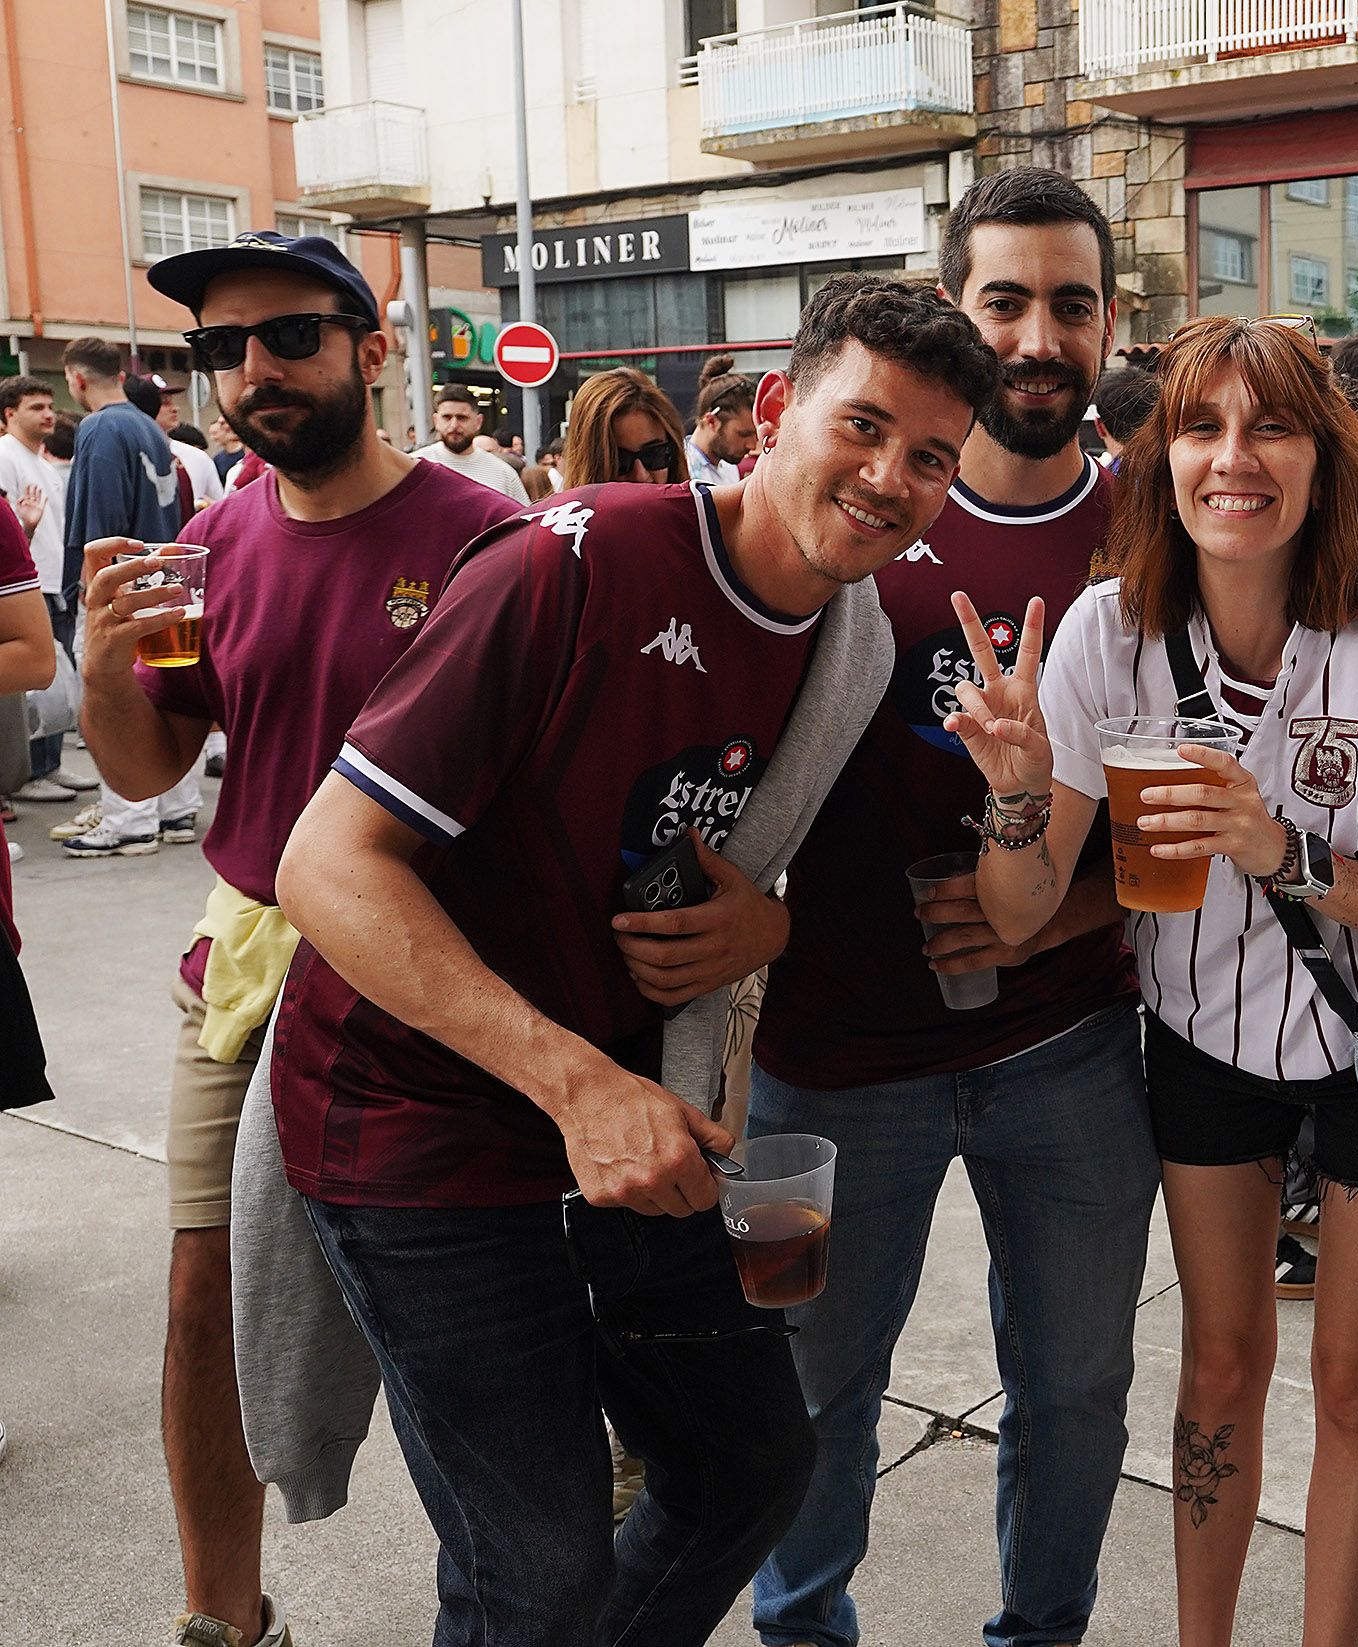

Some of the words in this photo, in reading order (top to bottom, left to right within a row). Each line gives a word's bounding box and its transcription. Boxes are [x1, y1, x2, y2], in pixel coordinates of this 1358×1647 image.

[503, 230, 661, 273] MOLINER
[659, 770, 753, 819] Estrel
[190, 1617, 221, 1635] AUTRY
